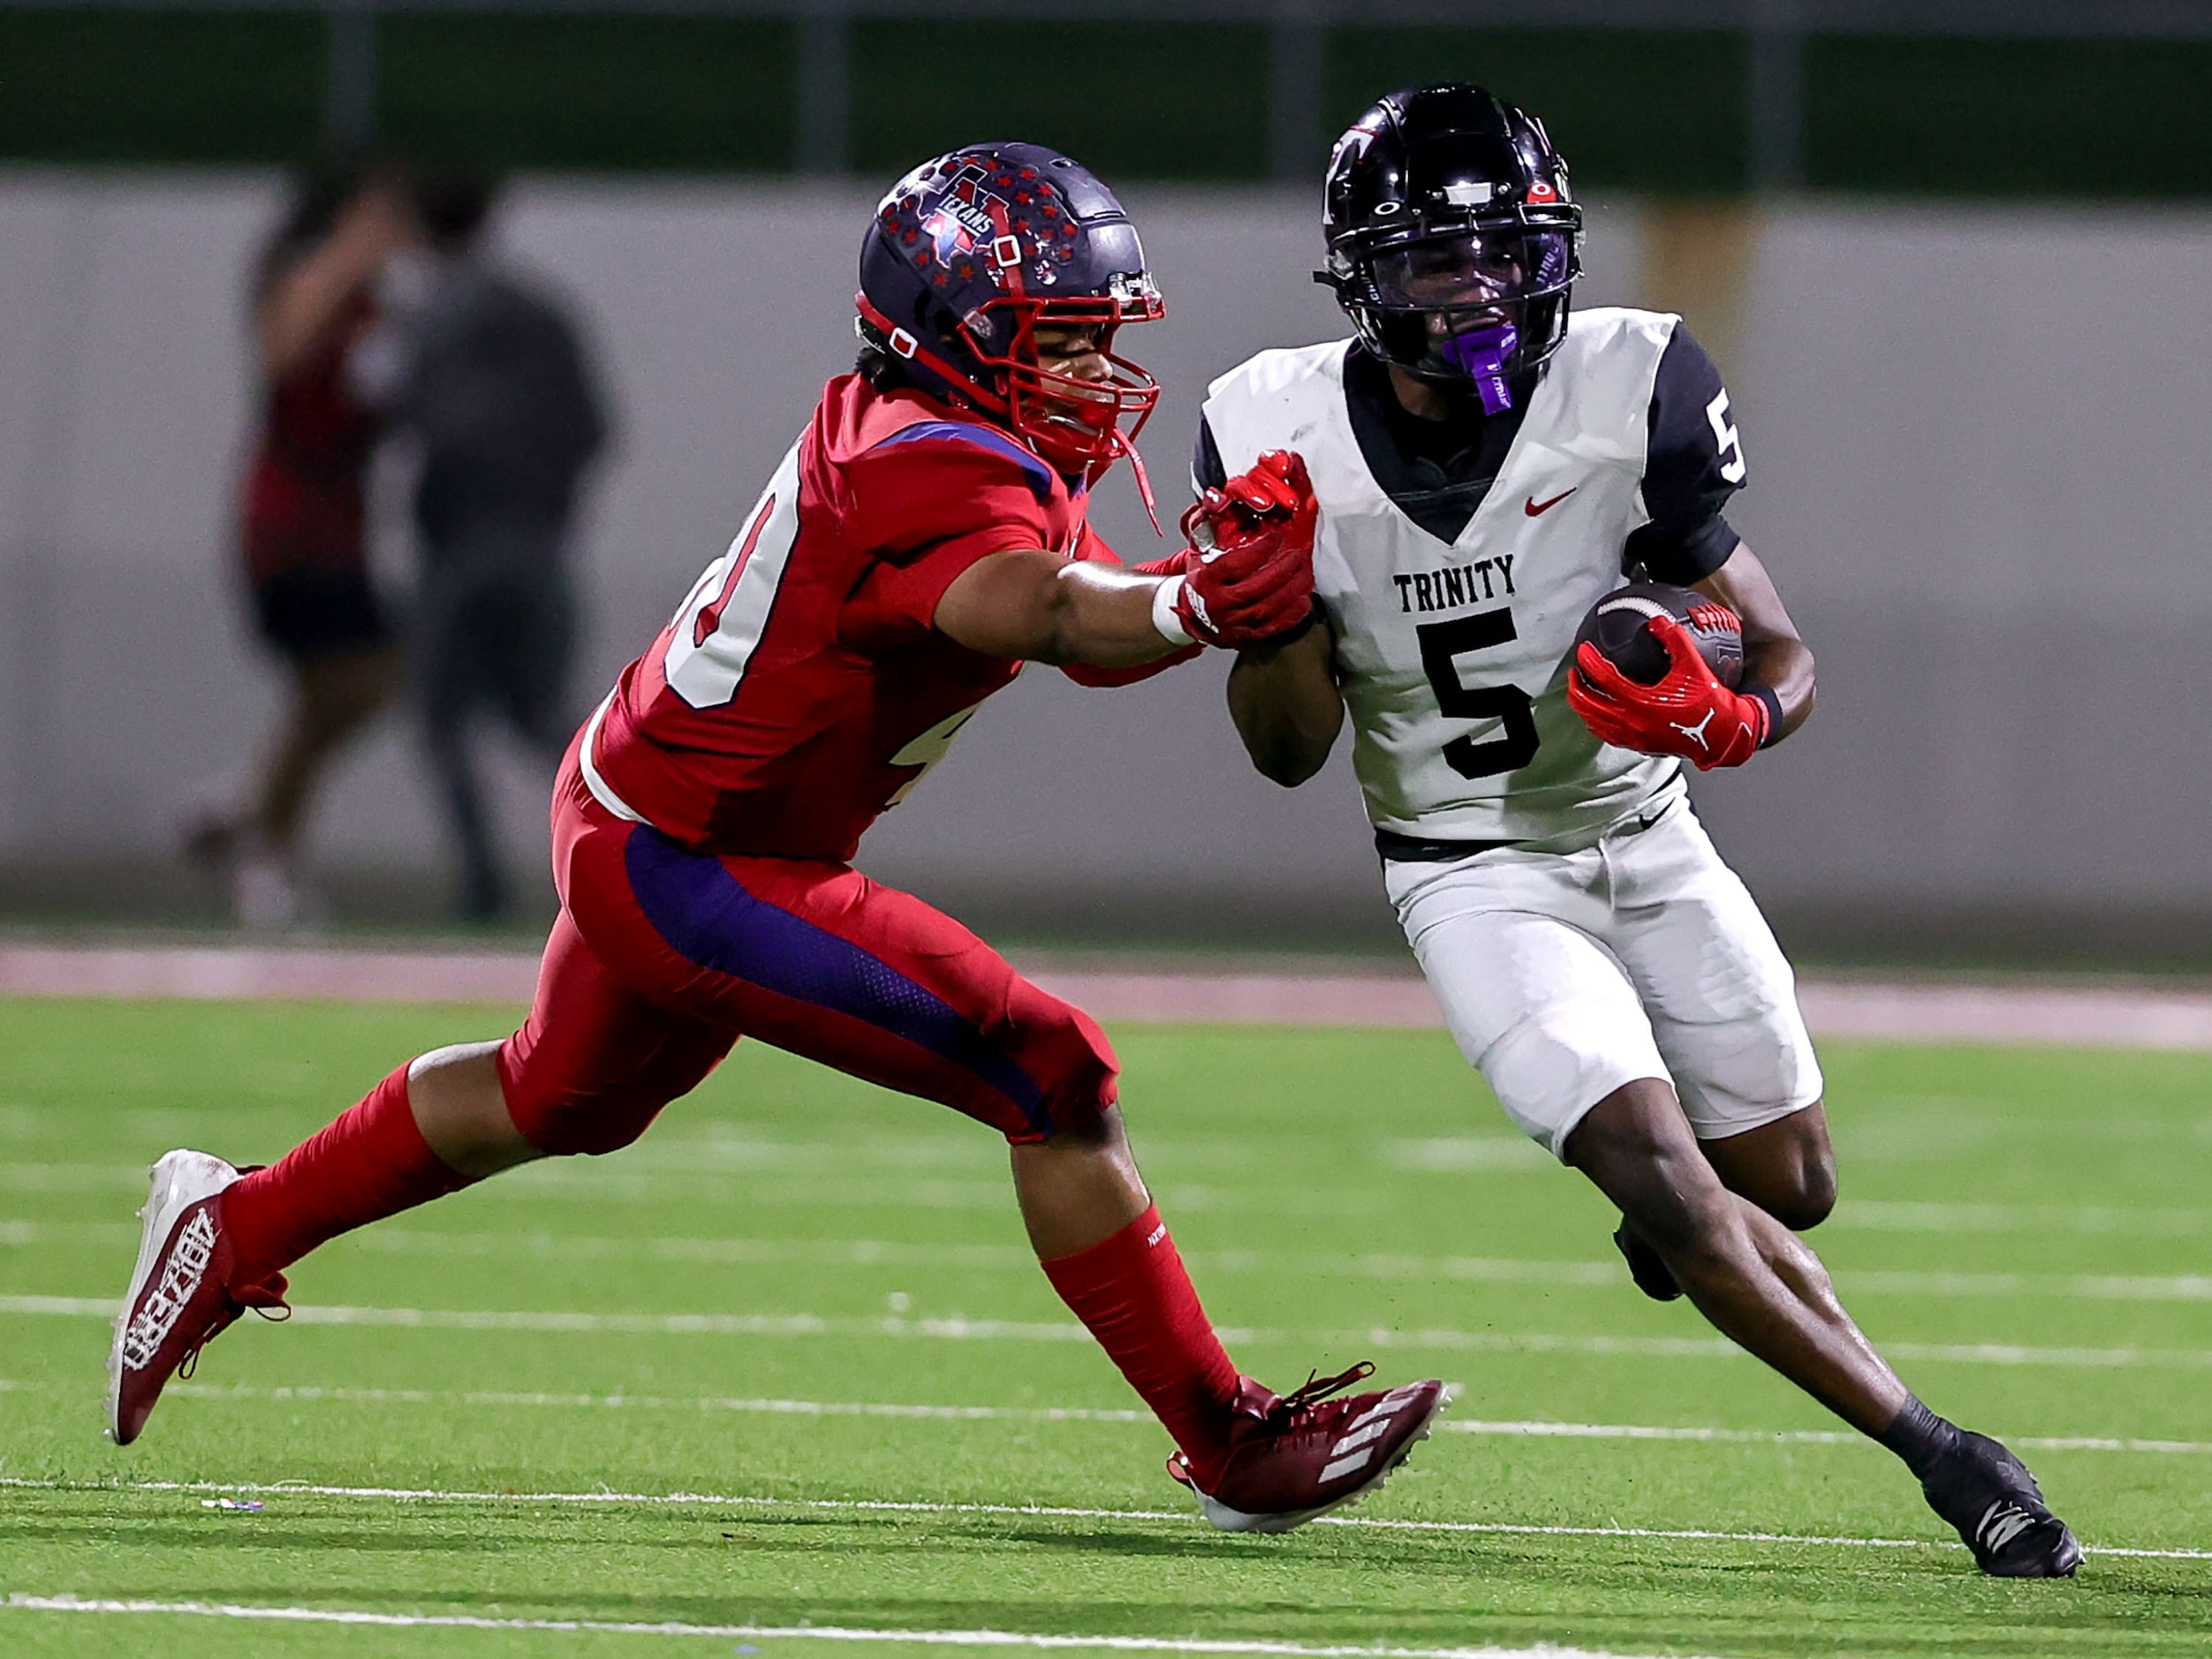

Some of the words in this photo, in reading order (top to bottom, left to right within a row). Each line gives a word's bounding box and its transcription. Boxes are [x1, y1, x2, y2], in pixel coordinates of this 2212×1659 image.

[938, 192, 995, 234] TEXANS
[1706, 387, 1747, 484] 5
[1393, 554, 1516, 612] TRINITY
[1415, 606, 1540, 780] 5
